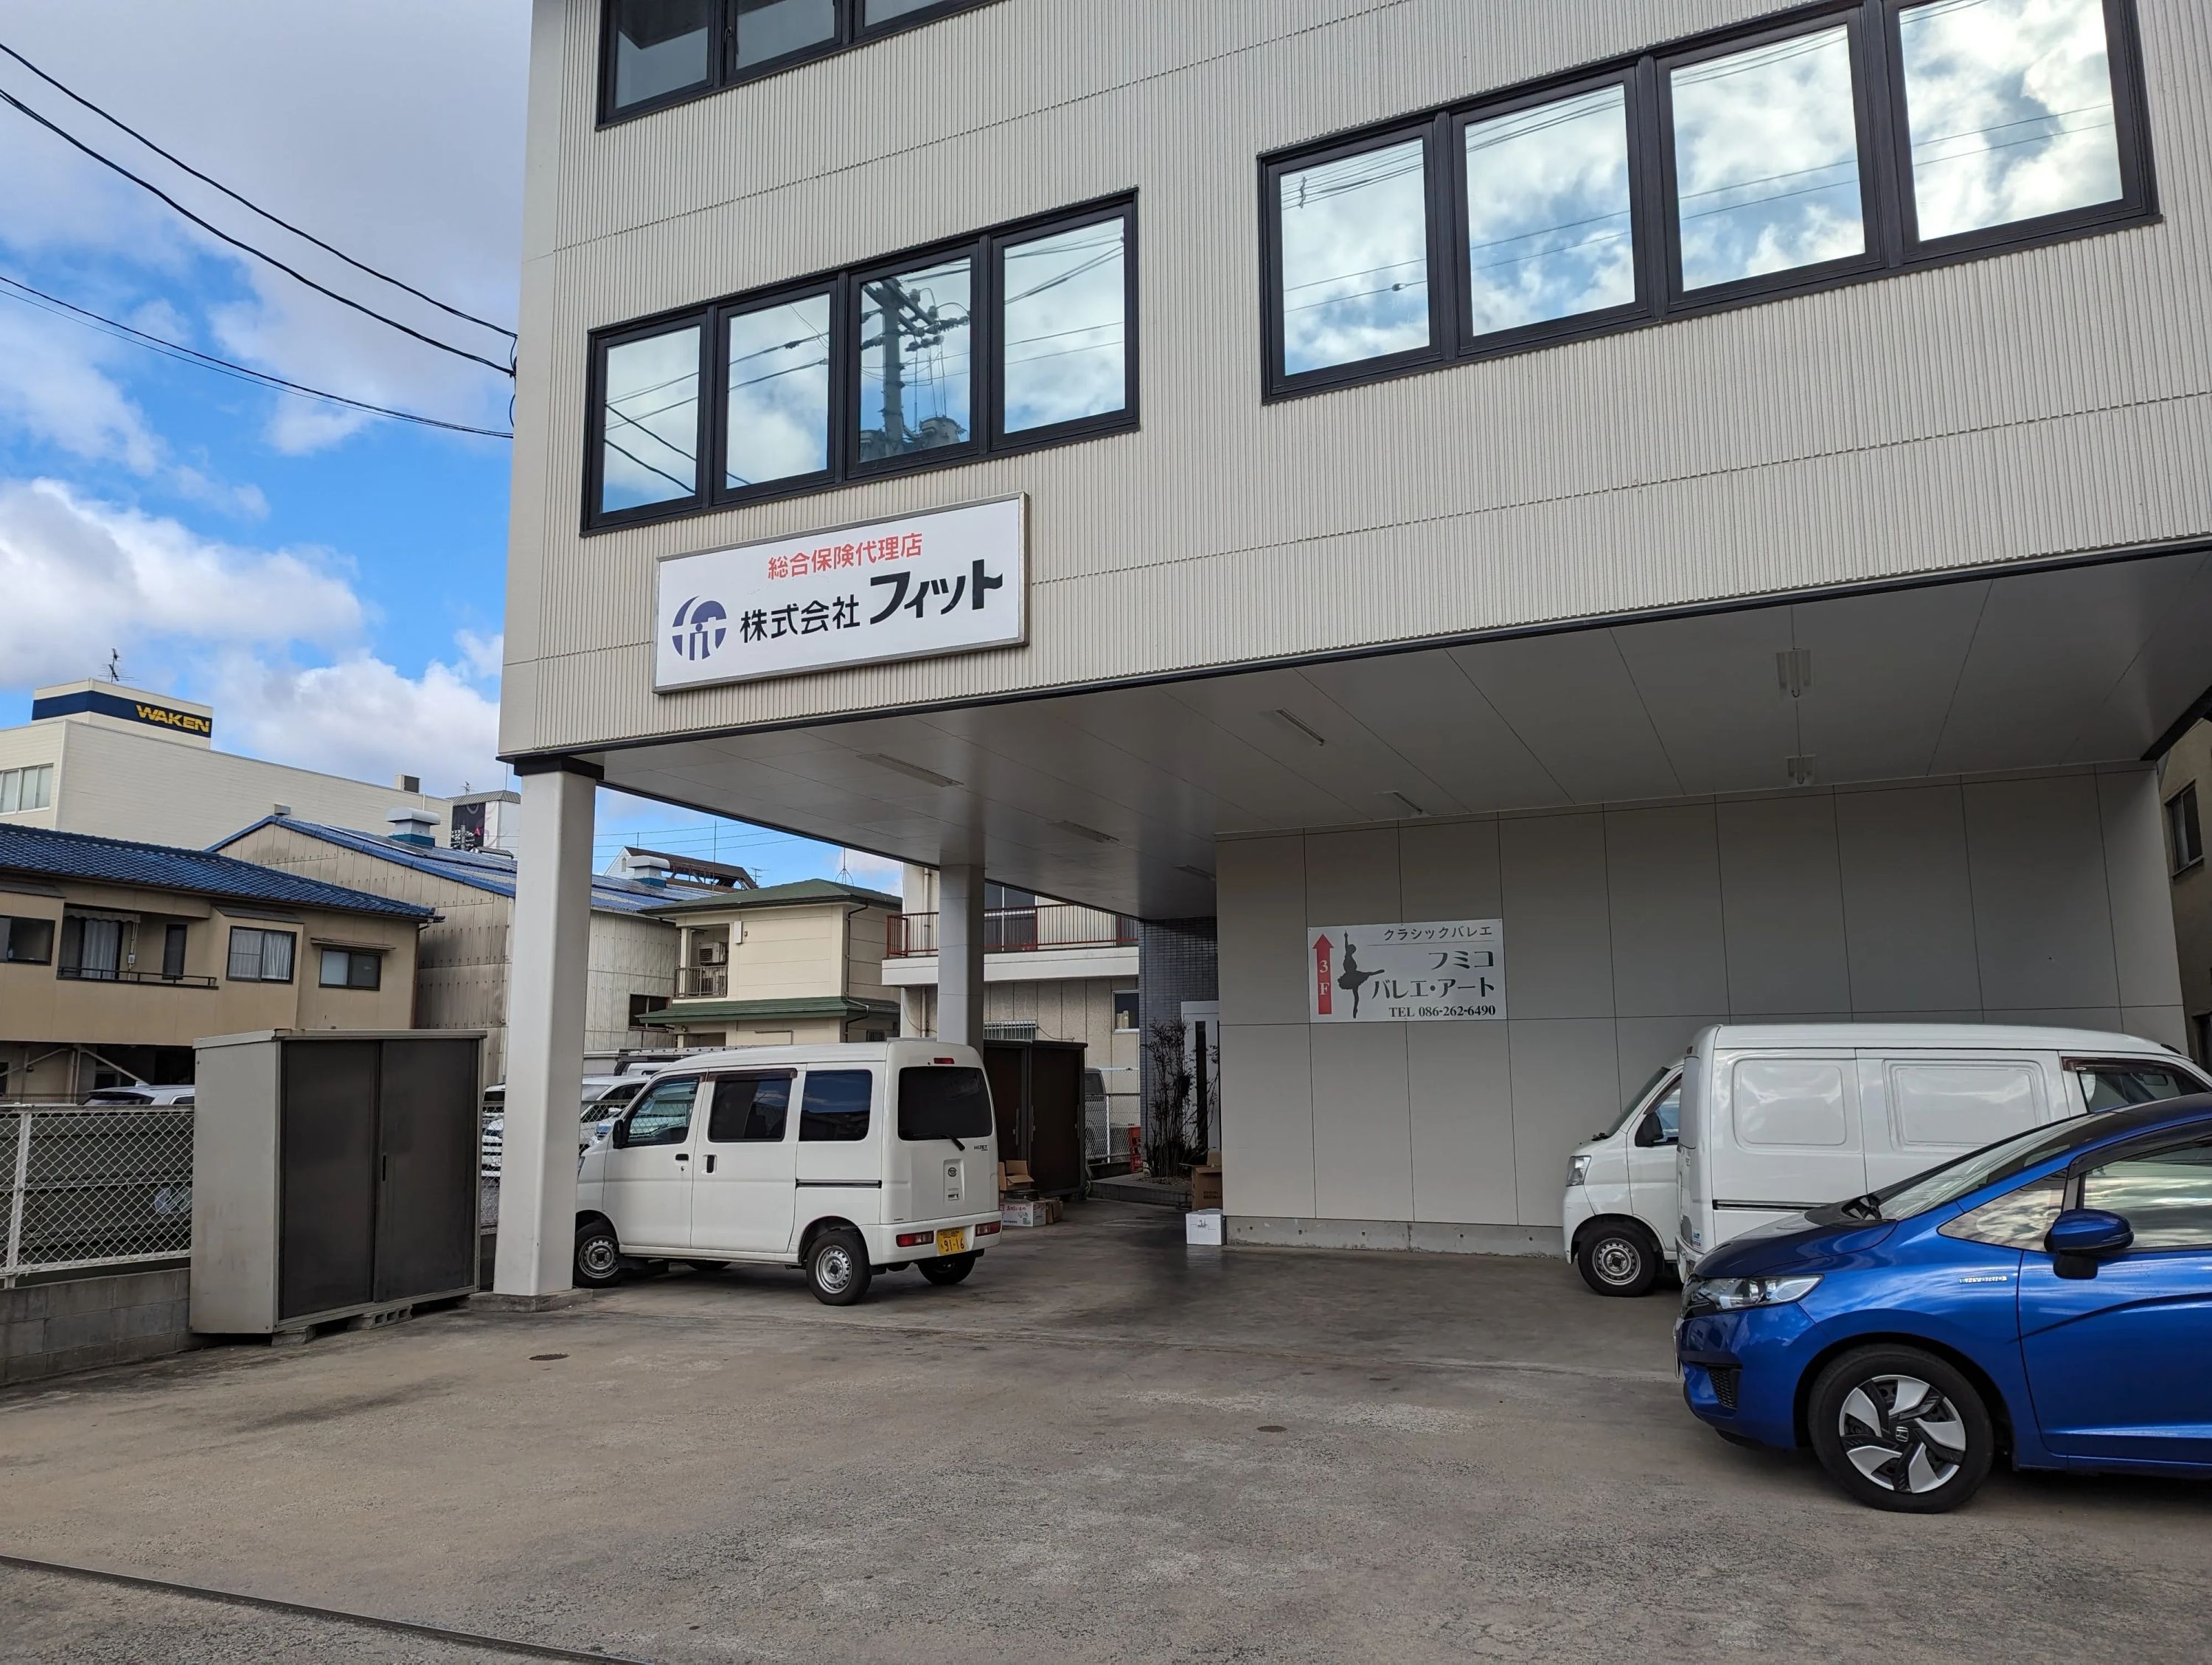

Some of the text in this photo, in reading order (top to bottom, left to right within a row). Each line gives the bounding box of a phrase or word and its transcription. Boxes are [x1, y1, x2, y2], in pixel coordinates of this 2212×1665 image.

[767, 532, 922, 581] 総合保険代理店
[136, 704, 210, 733] WAKEN
[1383, 925, 1492, 942] クラシックバレエ
[1427, 950, 1495, 970] フミコ
[1371, 976, 1495, 1000] バレエ・アート
[1388, 1004, 1496, 1018] TEL 086-262-6490
